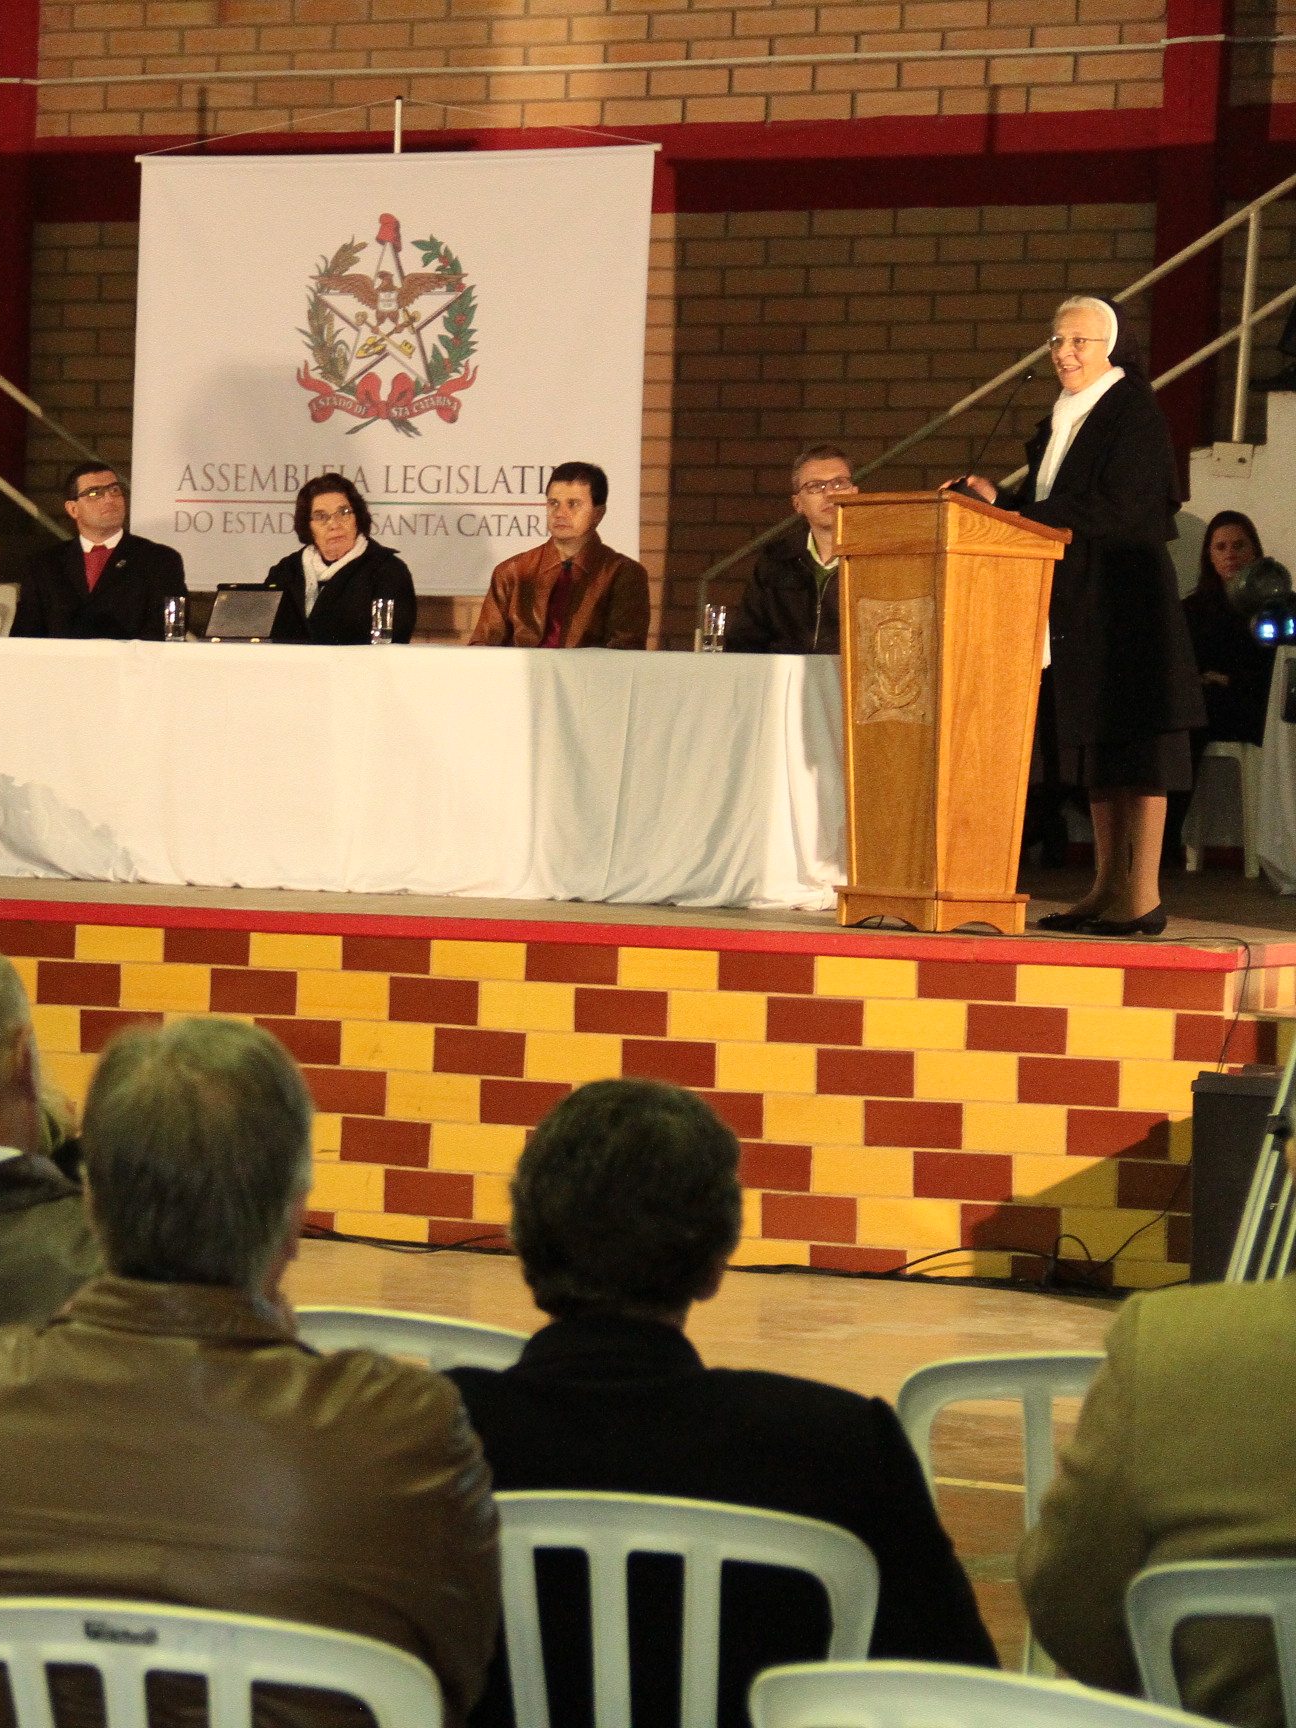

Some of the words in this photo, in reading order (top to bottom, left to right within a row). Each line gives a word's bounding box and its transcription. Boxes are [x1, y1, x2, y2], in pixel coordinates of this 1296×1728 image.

[384, 465, 558, 494] LEGISLATI
[174, 511, 213, 533] DO
[370, 513, 450, 537] SANTA
[457, 513, 551, 537] CATAR
